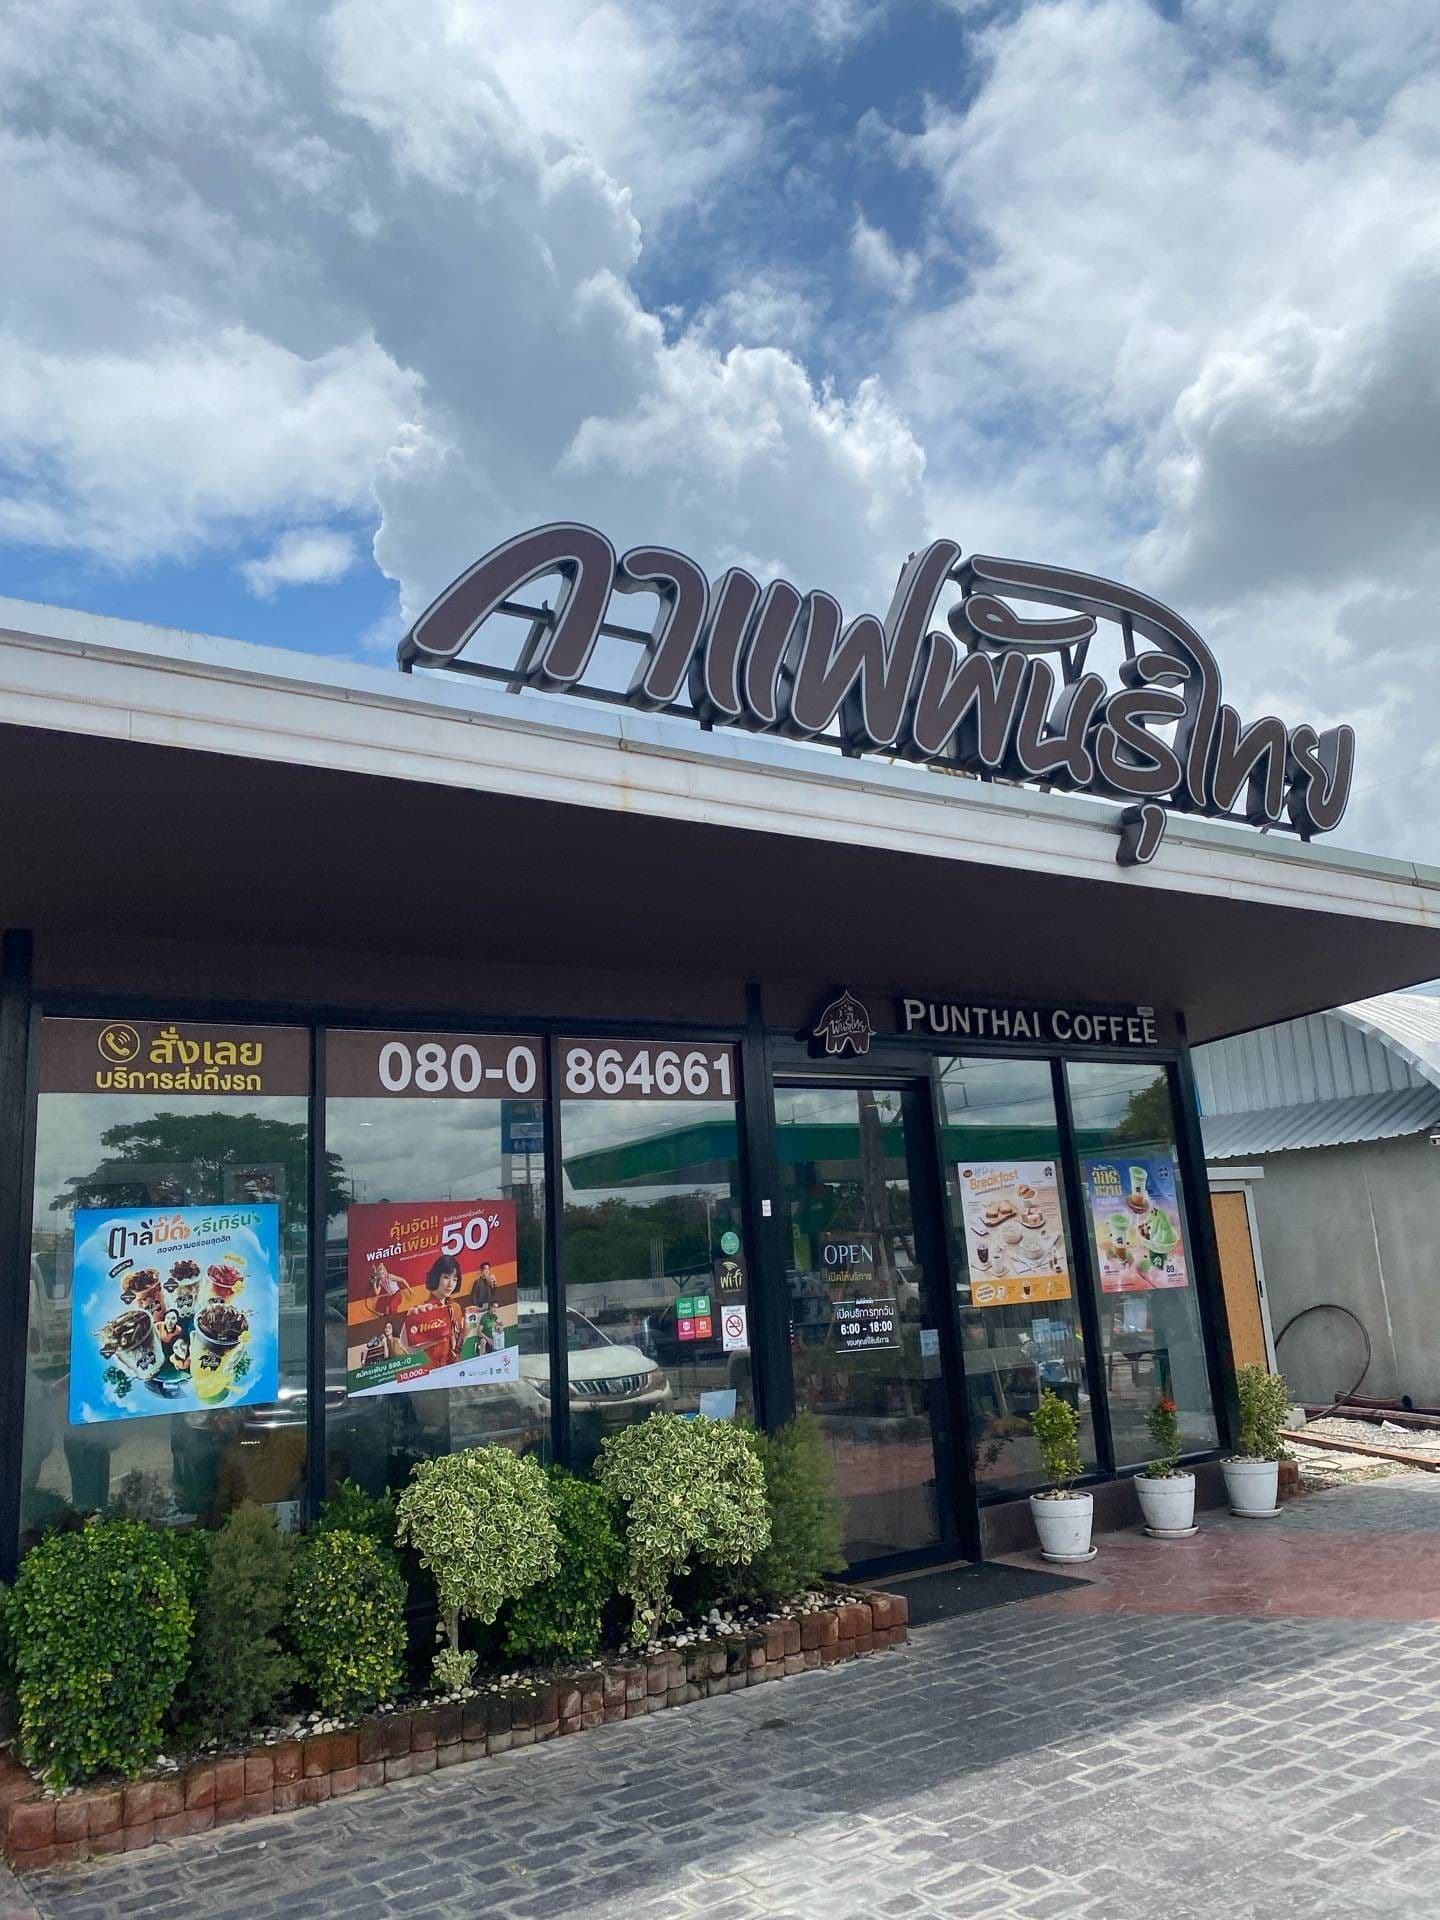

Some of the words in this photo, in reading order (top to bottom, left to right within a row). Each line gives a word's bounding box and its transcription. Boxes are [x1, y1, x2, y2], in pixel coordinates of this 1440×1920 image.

[400, 521, 1356, 867] กาแฟพันธุ์ไทย
[904, 998, 1041, 1038] PUNTHAI
[1052, 1009, 1159, 1044] COFFEE
[150, 1026, 263, 1066] สั่งเลย
[96, 1067, 262, 1091] บริการส่งถึงรถ
[378, 1041, 537, 1094] 080-0
[565, 1048, 732, 1095] 864661
[970, 1169, 1019, 1191] Breakfast
[201, 1213, 251, 1233] รีเทิร์น
[390, 1215, 439, 1241] คุ้มจัด!!
[824, 1244, 873, 1265] OPEN
[836, 1305, 894, 1320] เปิดบริการทุกวัน
[840, 1322, 861, 1335] 6:00
[868, 1320, 893, 1333] 18:00
